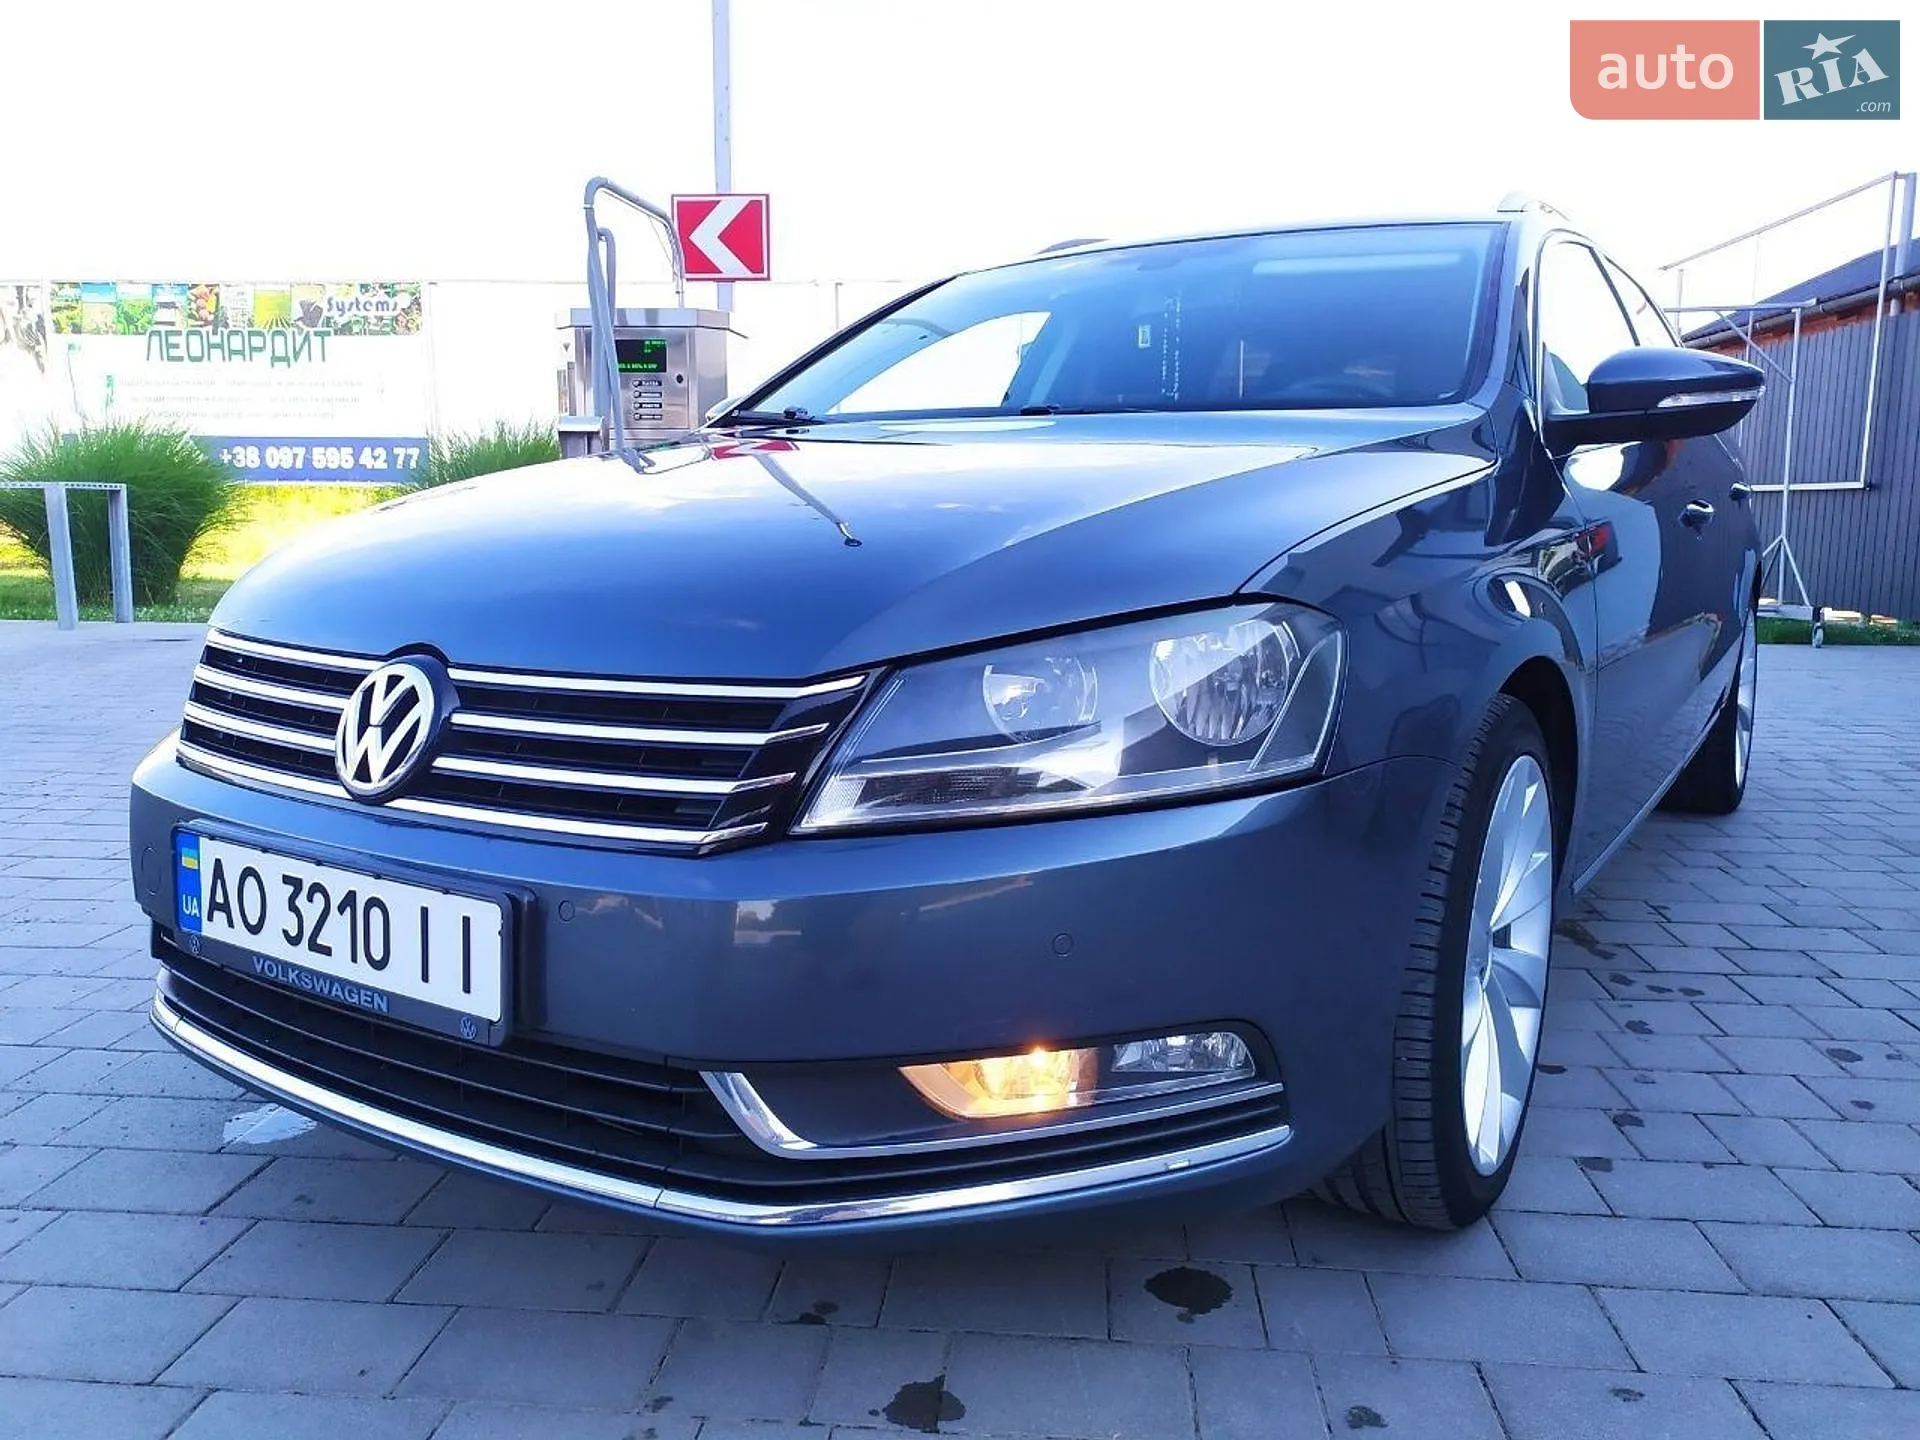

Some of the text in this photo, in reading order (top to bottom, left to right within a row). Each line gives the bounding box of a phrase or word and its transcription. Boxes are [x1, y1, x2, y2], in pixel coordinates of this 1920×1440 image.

[146, 328, 332, 368] ЛЕОНАРДИТ
[219, 445, 420, 470] +38 097 595 42 77
[182, 894, 200, 918] UA
[206, 857, 267, 936] AO
[281, 873, 391, 972] 3210
[251, 955, 390, 1014] VOLKSWAGEN
